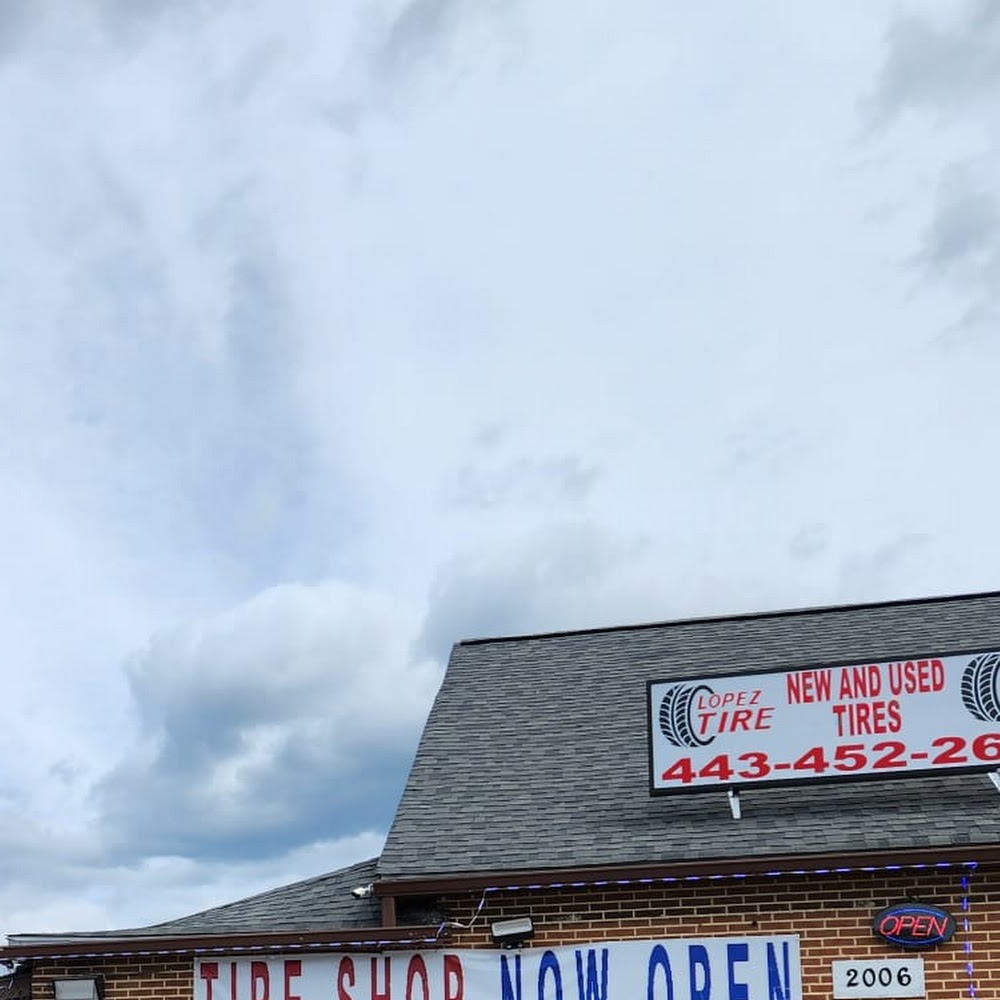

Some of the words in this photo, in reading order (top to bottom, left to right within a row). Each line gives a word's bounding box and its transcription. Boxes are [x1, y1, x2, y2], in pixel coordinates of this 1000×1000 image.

[787, 670, 832, 704] NEW
[839, 664, 881, 700] AND
[888, 659, 945, 695] USED
[697, 690, 763, 710] LOPEZ
[698, 707, 775, 735] TIRE
[832, 700, 902, 737] TIRES
[878, 915, 949, 938] OPEN
[846, 967, 912, 988] 2006
